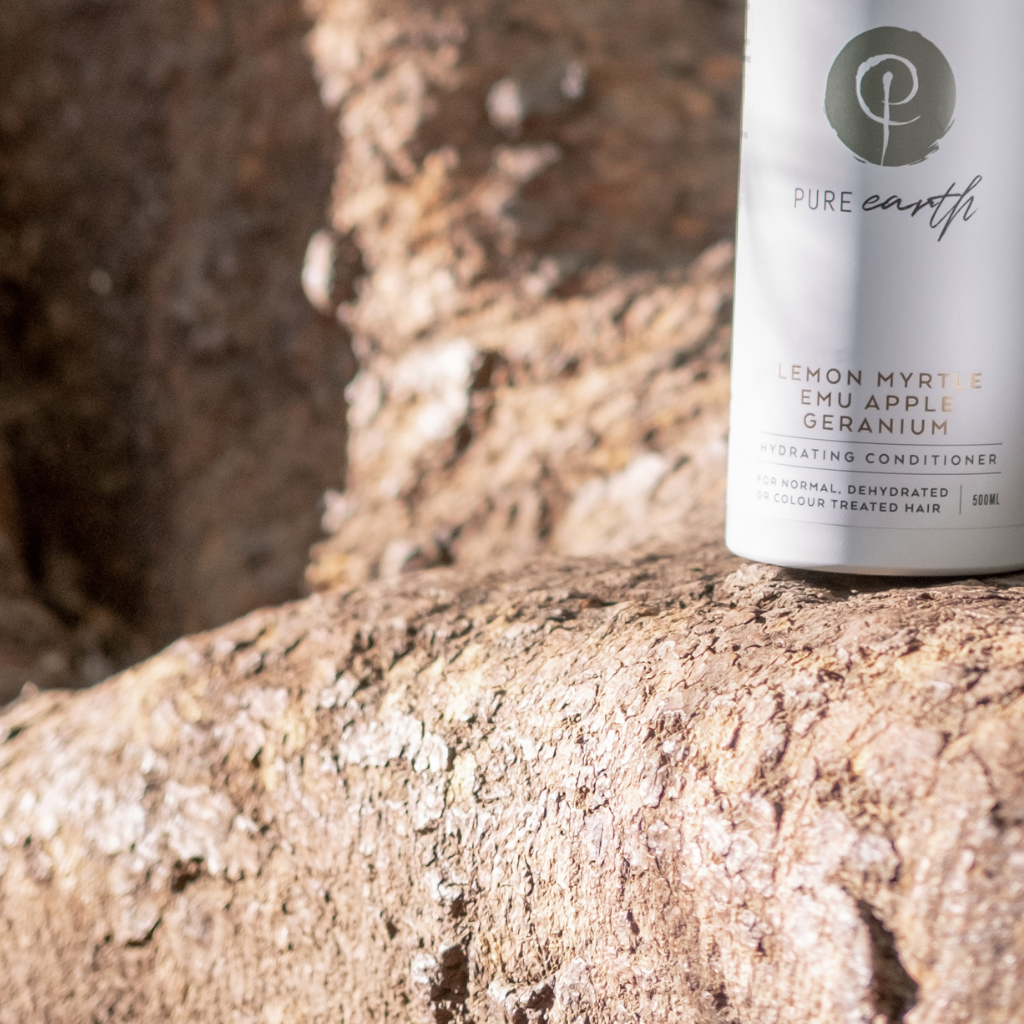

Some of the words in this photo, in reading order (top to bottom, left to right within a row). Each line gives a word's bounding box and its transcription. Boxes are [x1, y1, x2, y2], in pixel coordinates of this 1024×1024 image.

[794, 187, 853, 213] PURE
[862, 175, 982, 242] earth
[778, 363, 862, 387] LEMON
[876, 371, 983, 390] MYRTLE
[800, 389, 852, 409] EMU
[864, 394, 954, 413] APPLE
[803, 412, 948, 435] GERANIUM
[760, 442, 855, 463] HYDRATING
[865, 452, 998, 466] CONDITIONER
[756, 475, 777, 486] FOR
[781, 478, 842, 495] NORMAL,
[847, 484, 949, 498] DEHYDRATED
[757, 490, 770, 501] OR
[773, 493, 826, 508] COLOUR
[830, 498, 898, 513] TREATED
[904, 502, 941, 514] HAIR
[972, 493, 1000, 506] 500ML
